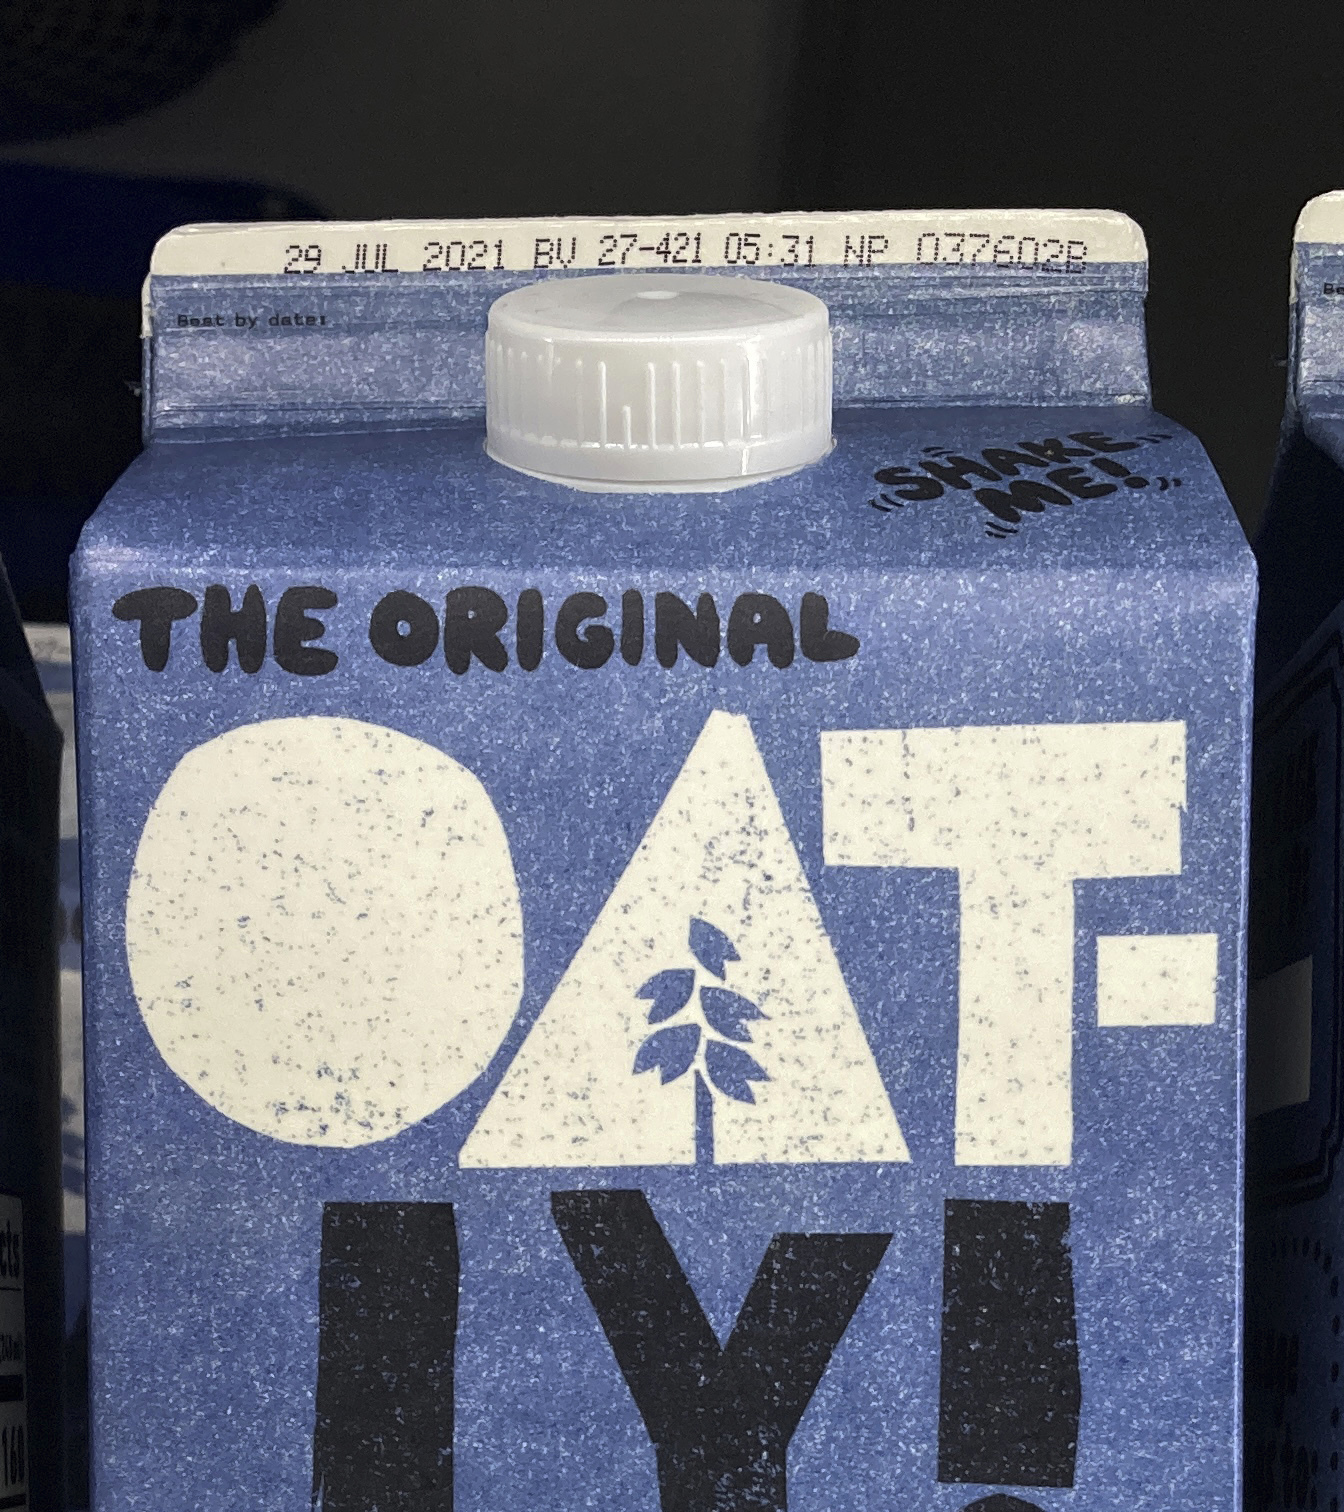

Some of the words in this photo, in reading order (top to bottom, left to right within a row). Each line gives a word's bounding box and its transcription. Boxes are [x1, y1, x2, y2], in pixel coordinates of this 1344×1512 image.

[284, 244, 322, 275] 29
[342, 243, 399, 274] JUL
[422, 239, 505, 272] 2021
[533, 237, 577, 269] BV
[598, 233, 702, 267] 27-421
[724, 232, 815, 268] 05:31
[843, 233, 889, 267] NP
[177, 312, 225, 328] Best
[235, 312, 259, 330] by
[268, 312, 328, 328] date:
[873, 432, 1142, 501] SHAKE
[974, 457, 1150, 523] ME!
[111, 583, 340, 676] THE
[368, 585, 861, 674] ORIGINAL
[125, 708, 1219, 1169] OAT-
